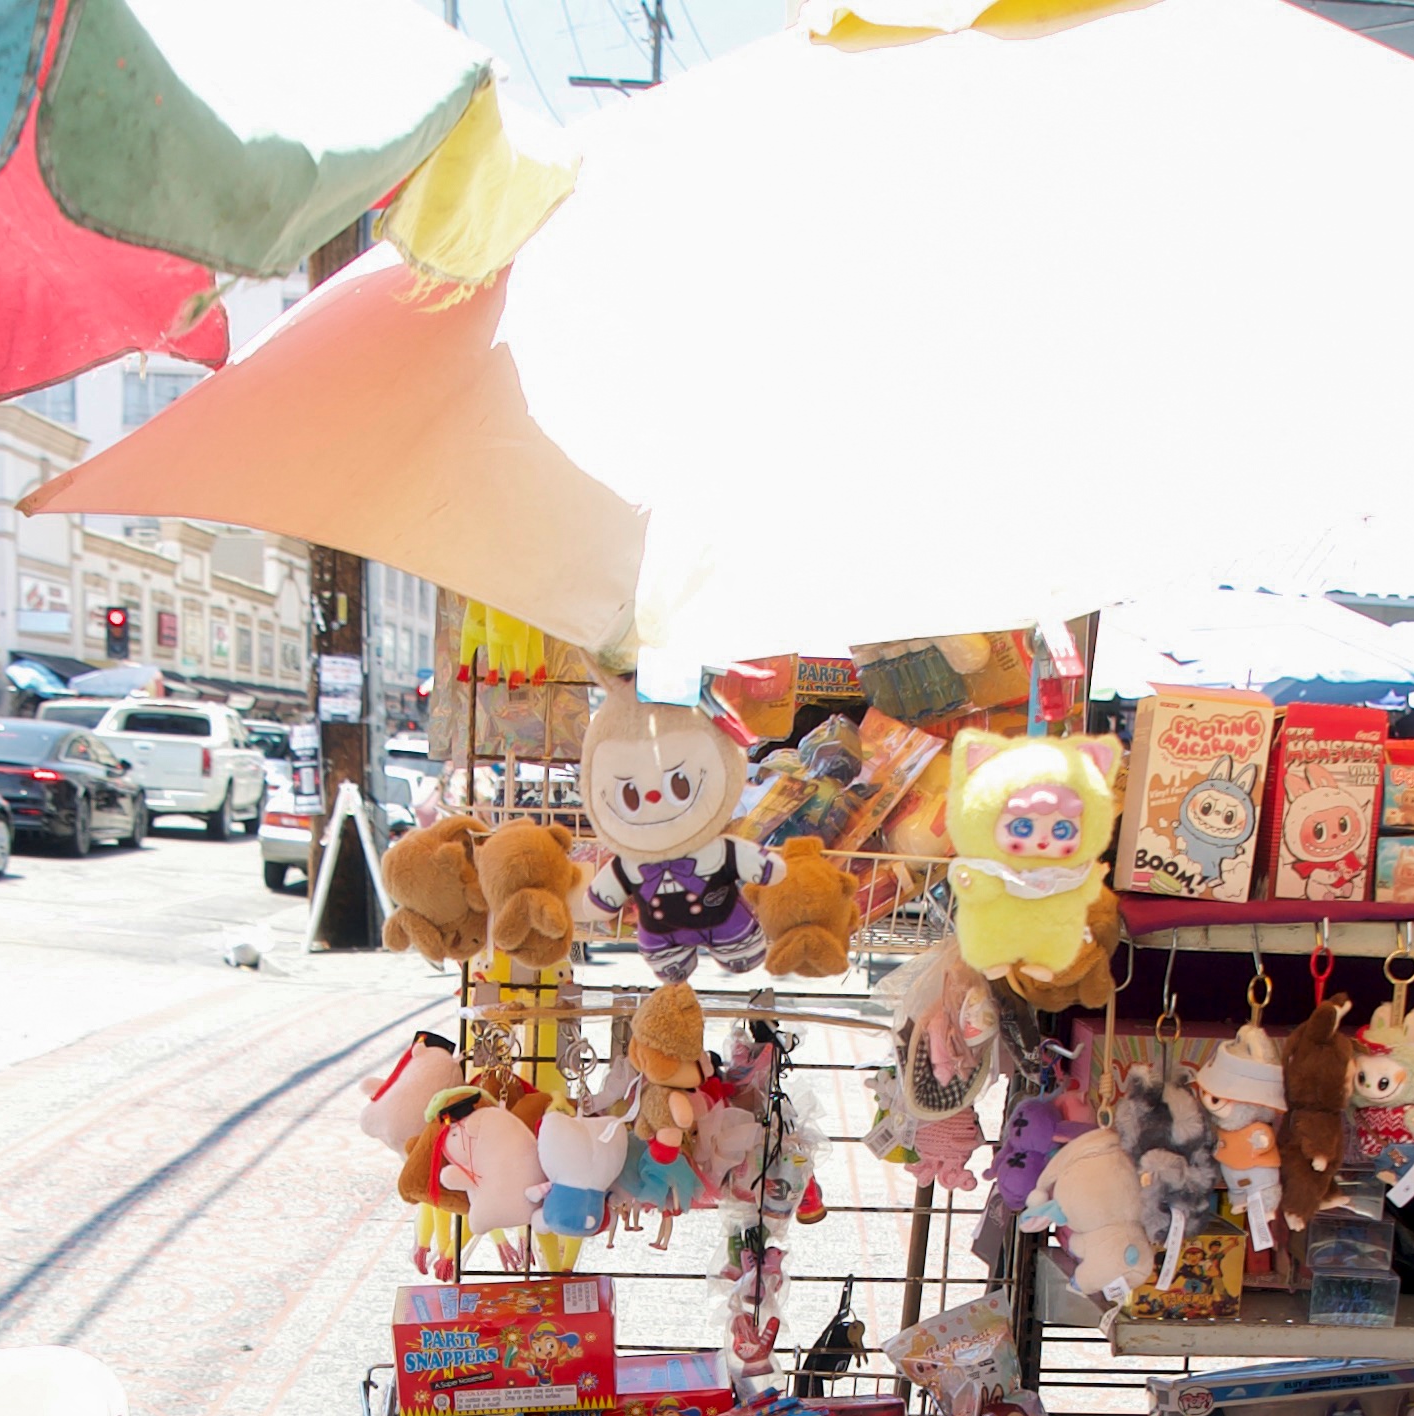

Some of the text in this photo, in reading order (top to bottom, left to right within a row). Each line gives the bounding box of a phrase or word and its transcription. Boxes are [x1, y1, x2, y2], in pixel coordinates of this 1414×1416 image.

[798, 663, 850, 685] PARTY
[1175, 715, 1261, 741] EXCITING
[1163, 734, 1248, 761] MACARON
[1135, 850, 1208, 896] BOOM!
[420, 1330, 480, 1349] PARTY
[404, 1346, 499, 1373] SNAPPERS
